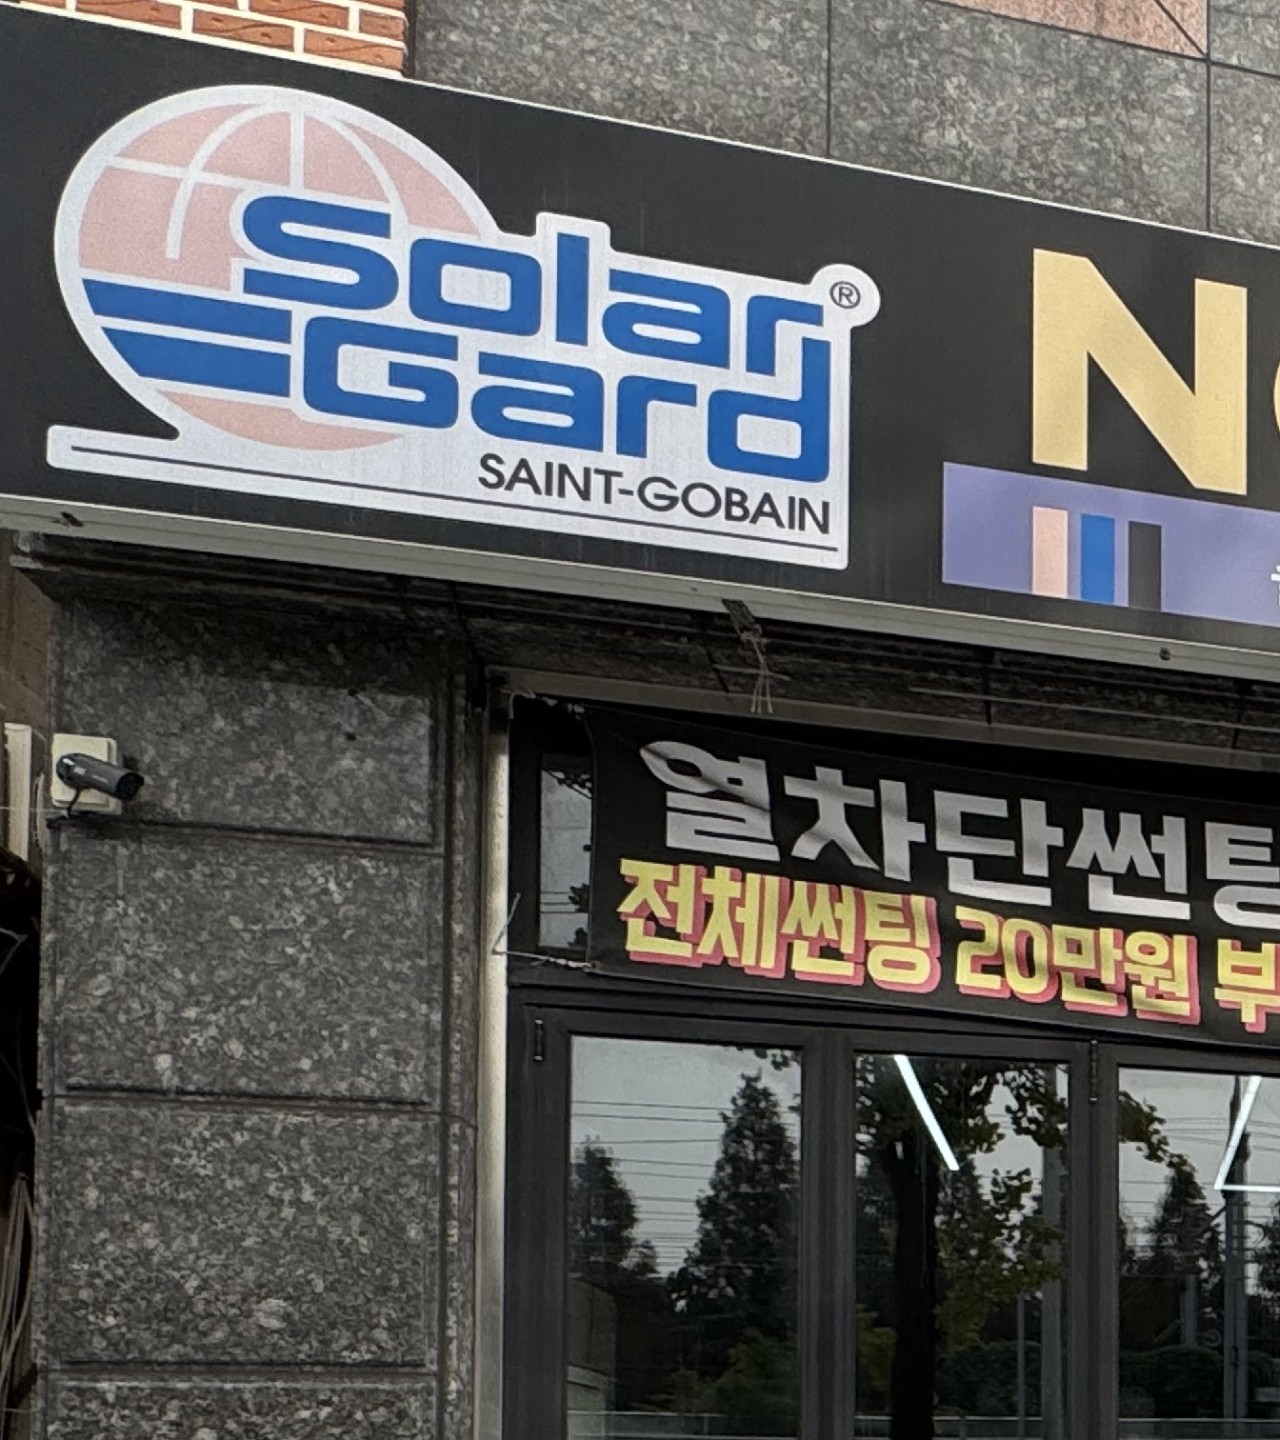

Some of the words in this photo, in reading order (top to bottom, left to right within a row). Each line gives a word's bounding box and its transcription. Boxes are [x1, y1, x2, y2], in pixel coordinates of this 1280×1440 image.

[241, 195, 825, 375] Solar
[302, 315, 832, 484] Gard
[477, 452, 832, 535] SAINT-GOBAIN
[616, 857, 944, 994] 전체썬팅
[954, 904, 1202, 1026] 20만원
